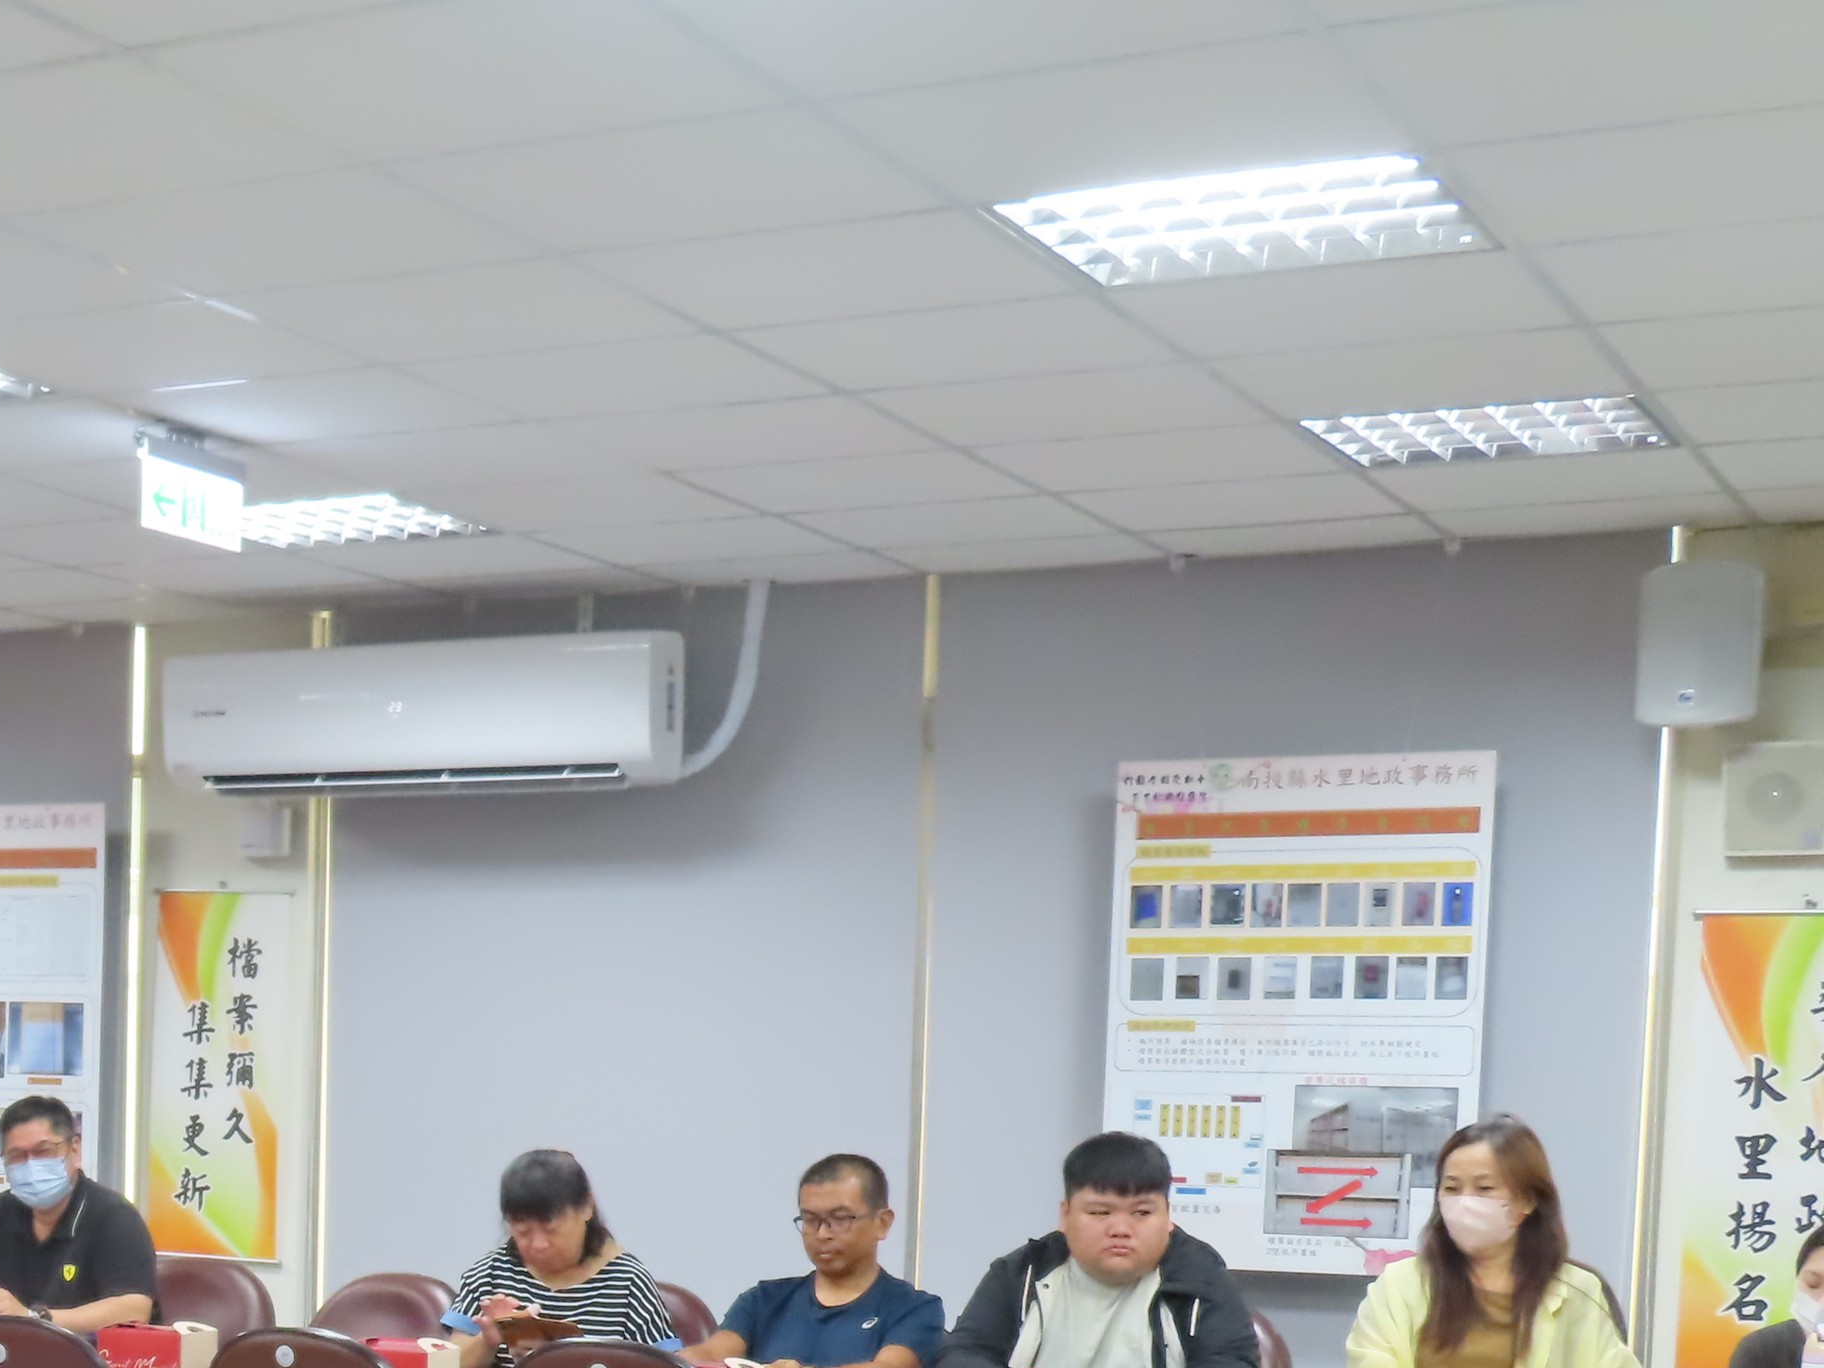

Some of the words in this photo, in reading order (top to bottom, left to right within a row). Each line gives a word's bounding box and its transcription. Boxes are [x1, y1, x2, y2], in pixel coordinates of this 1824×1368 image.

[174, 1002, 215, 1214] 集集更新
[223, 937, 263, 1145] 檔案彌久
[1722, 1057, 1787, 1322] 水里揚名
